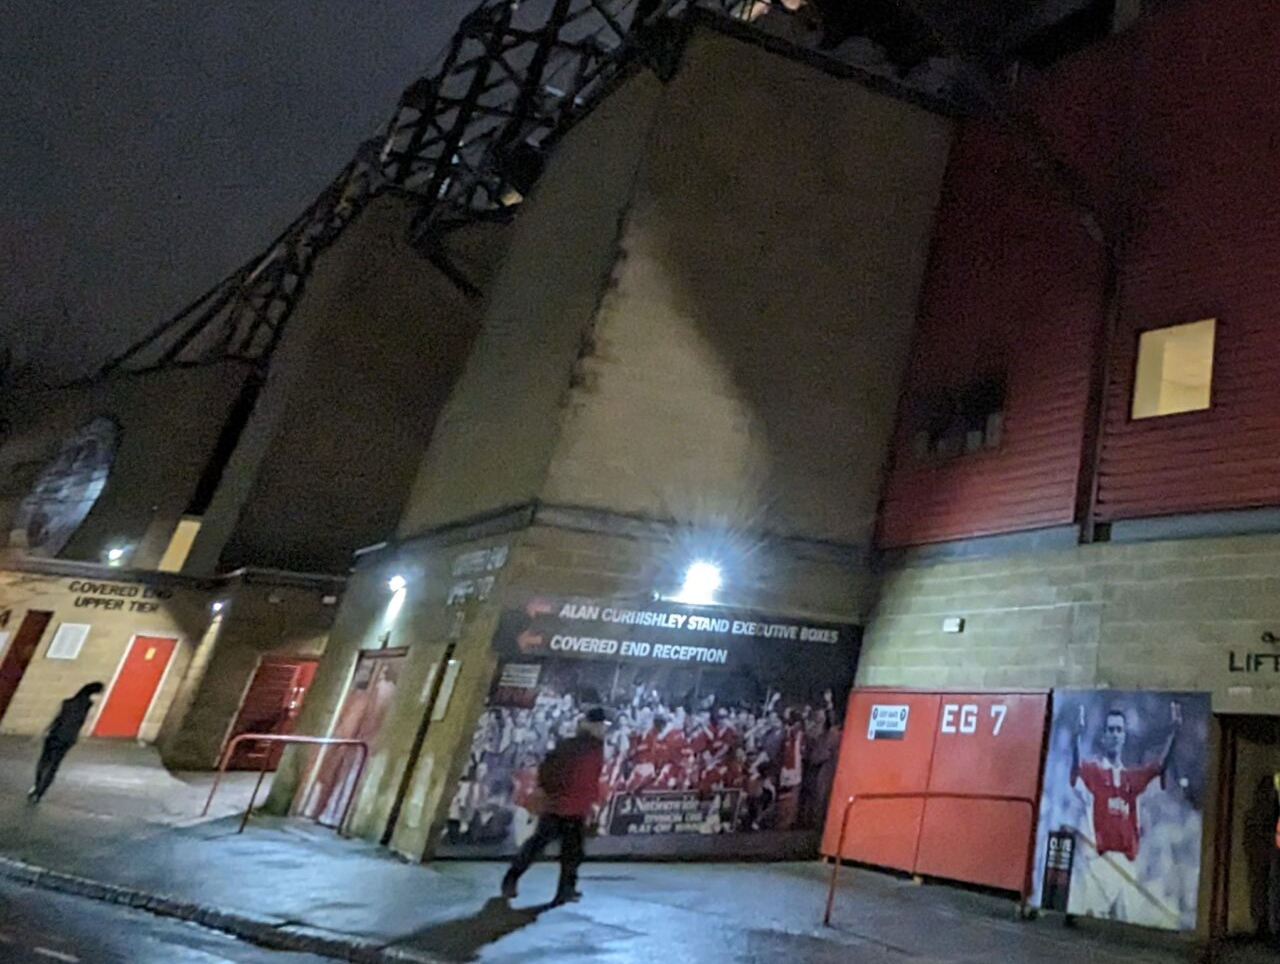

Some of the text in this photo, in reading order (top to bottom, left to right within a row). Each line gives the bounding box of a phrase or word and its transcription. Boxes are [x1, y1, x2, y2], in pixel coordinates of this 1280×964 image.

[69, 580, 138, 598] COVERED
[74, 596, 160, 613] UPPER TIER
[559, 603, 600, 620] ALAN
[686, 615, 729, 633] STAND
[731, 620, 799, 640] EXECUTIVE
[800, 626, 839, 644] BOXES
[550, 635, 727, 664] COVERED END RECEPTION
[941, 704, 1007, 736] EG 7
